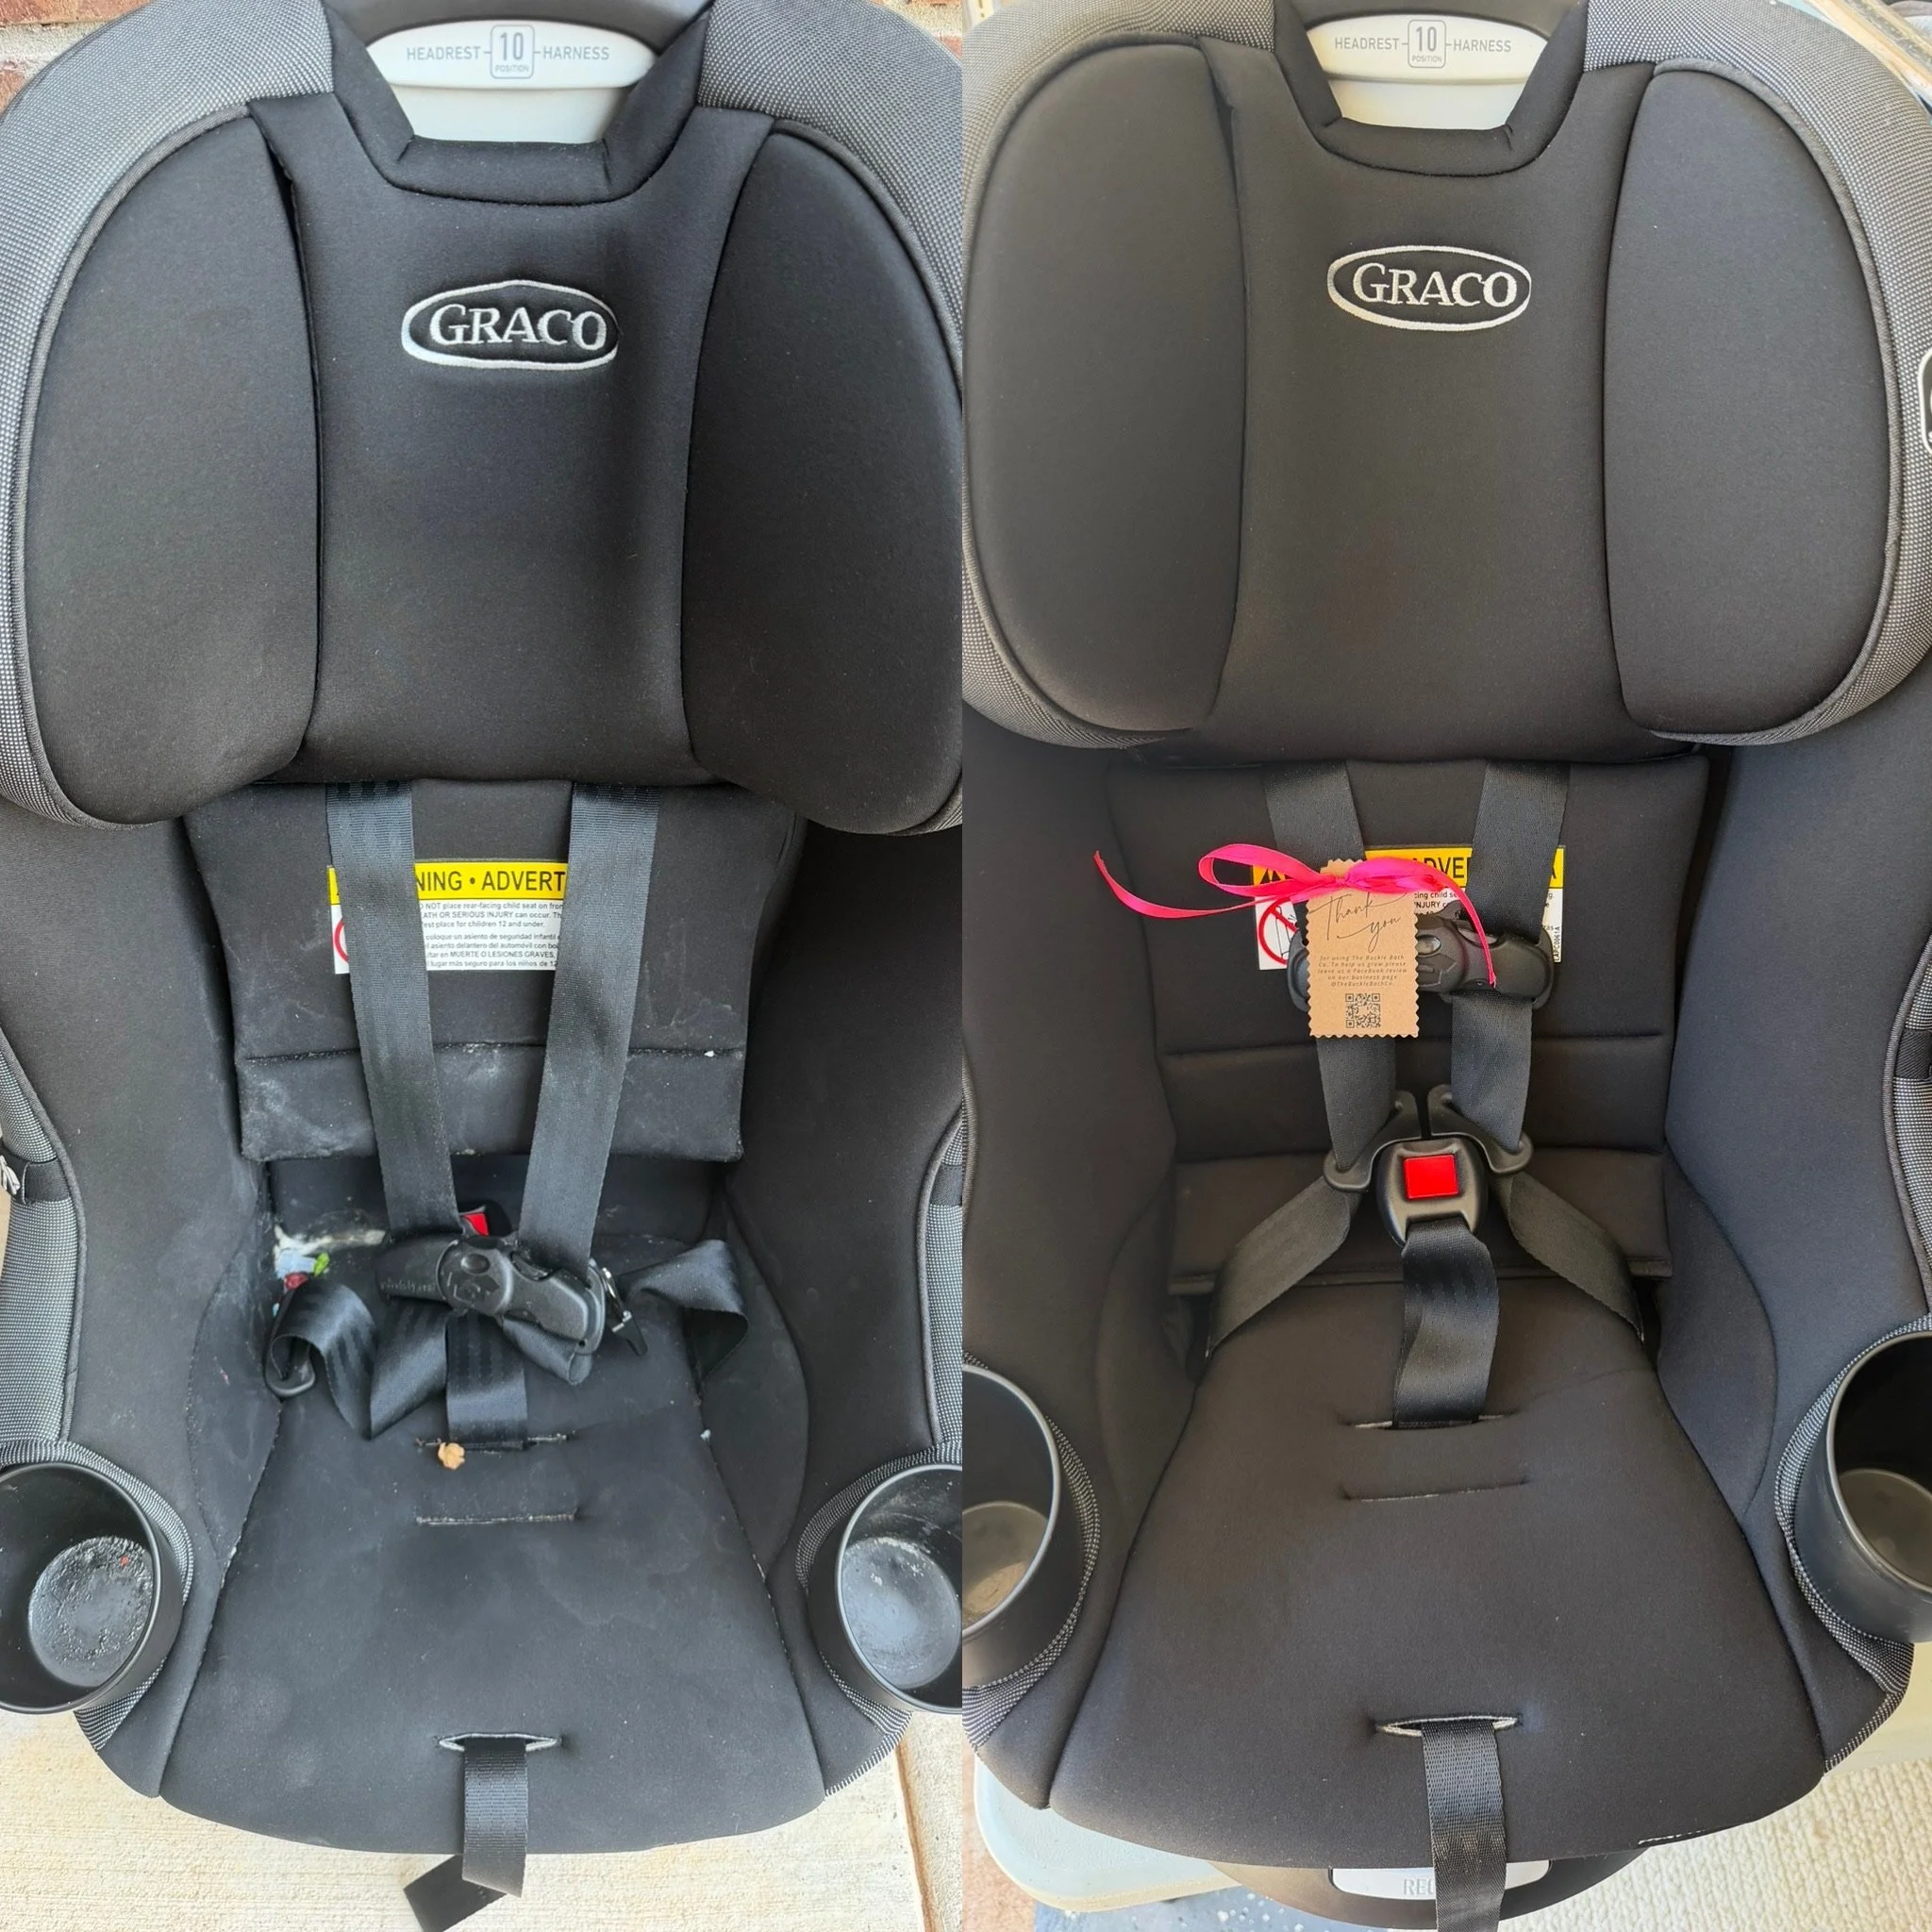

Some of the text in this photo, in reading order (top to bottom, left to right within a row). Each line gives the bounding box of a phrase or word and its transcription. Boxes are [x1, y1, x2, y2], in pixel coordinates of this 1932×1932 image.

[407, 32, 610, 60] HEADREST 10 HARNESS
[1335, 26, 1511, 53] HEADREST 10 HARNESS
[494, 64, 529, 73] POSITION
[1352, 262, 1518, 308] GRACO
[428, 303, 608, 351] GRACO
[481, 870, 566, 891] ADVERT
[442, 902, 461, 910] place
[463, 902, 502, 910] rear-facing
[452, 910, 485, 919] SERIOUS
[487, 910, 514, 919] INJURY
[1309, 891, 1407, 941] Thank
[435, 921, 455, 929] place
[457, 920, 467, 928] for
[1337, 917, 1401, 954] you
